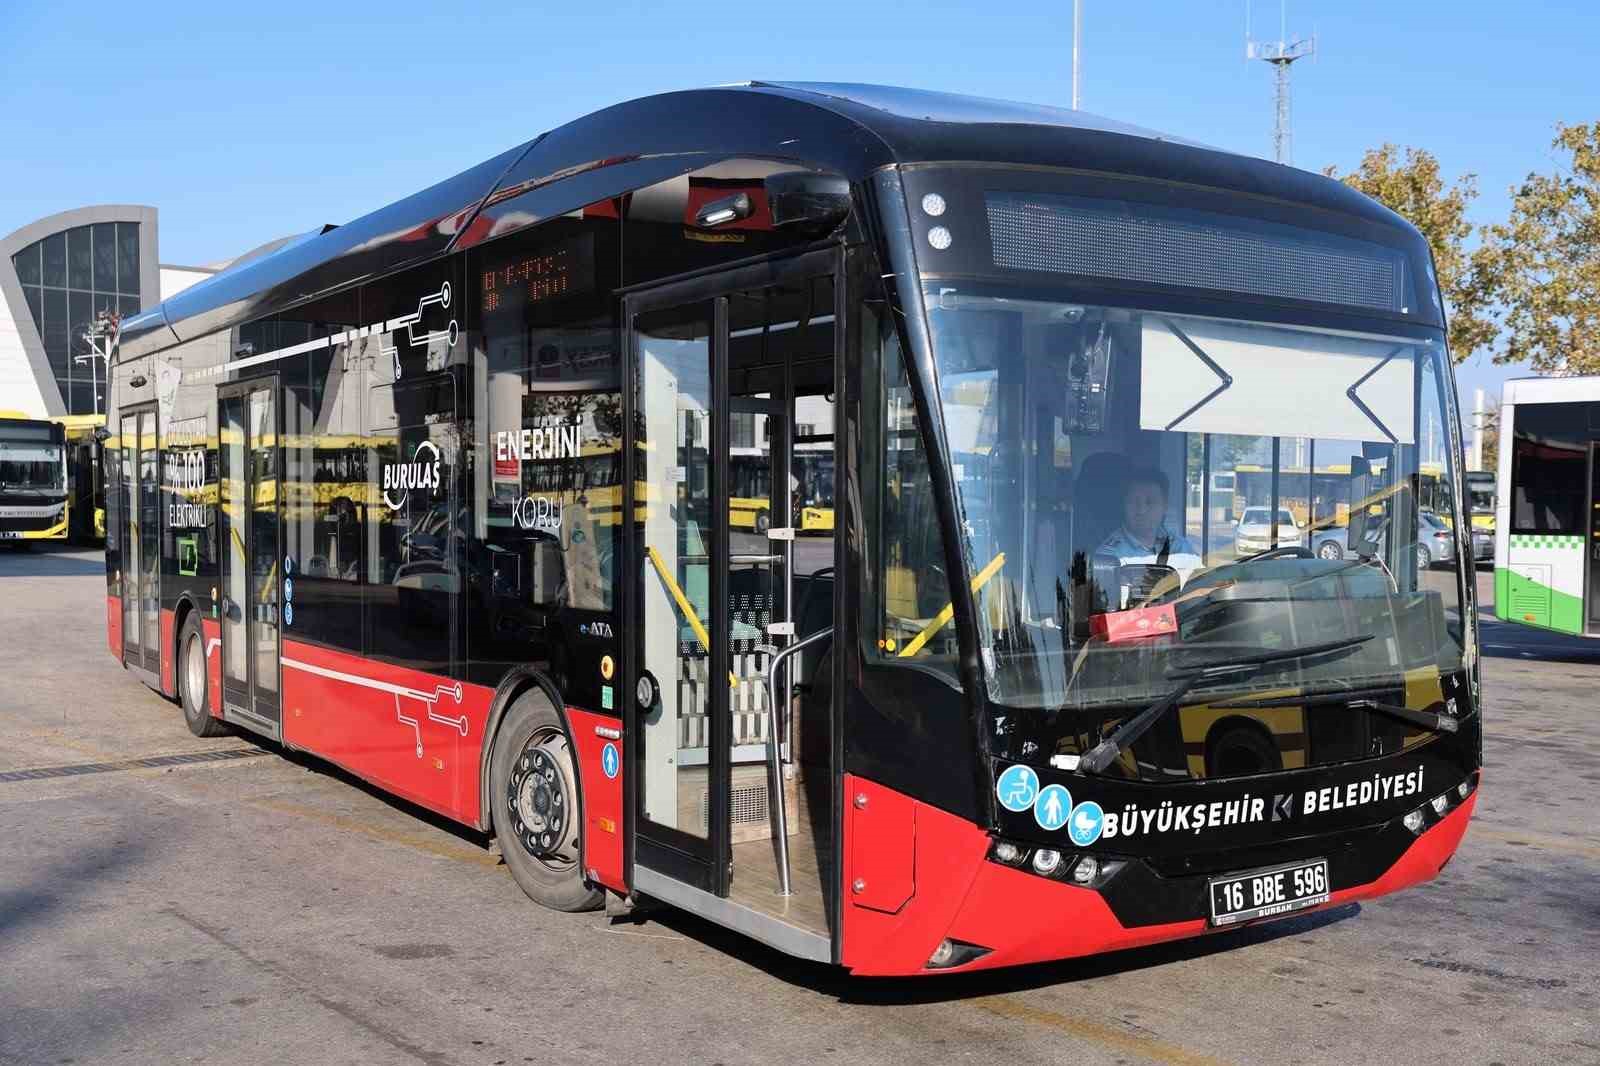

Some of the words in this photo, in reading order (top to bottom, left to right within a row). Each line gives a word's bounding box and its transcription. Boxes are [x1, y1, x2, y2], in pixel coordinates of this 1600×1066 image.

[497, 413, 581, 461] ENERJİNİ
[383, 461, 440, 496] BURULAŞ
[512, 496, 564, 529] KORU
[1102, 793, 1264, 839] BÜYÜKŞEHİR
[1302, 765, 1425, 815] BELEDİYESİ
[1224, 882, 1244, 911] 16
[1252, 873, 1286, 906] BBE
[1293, 865, 1325, 897] 596
